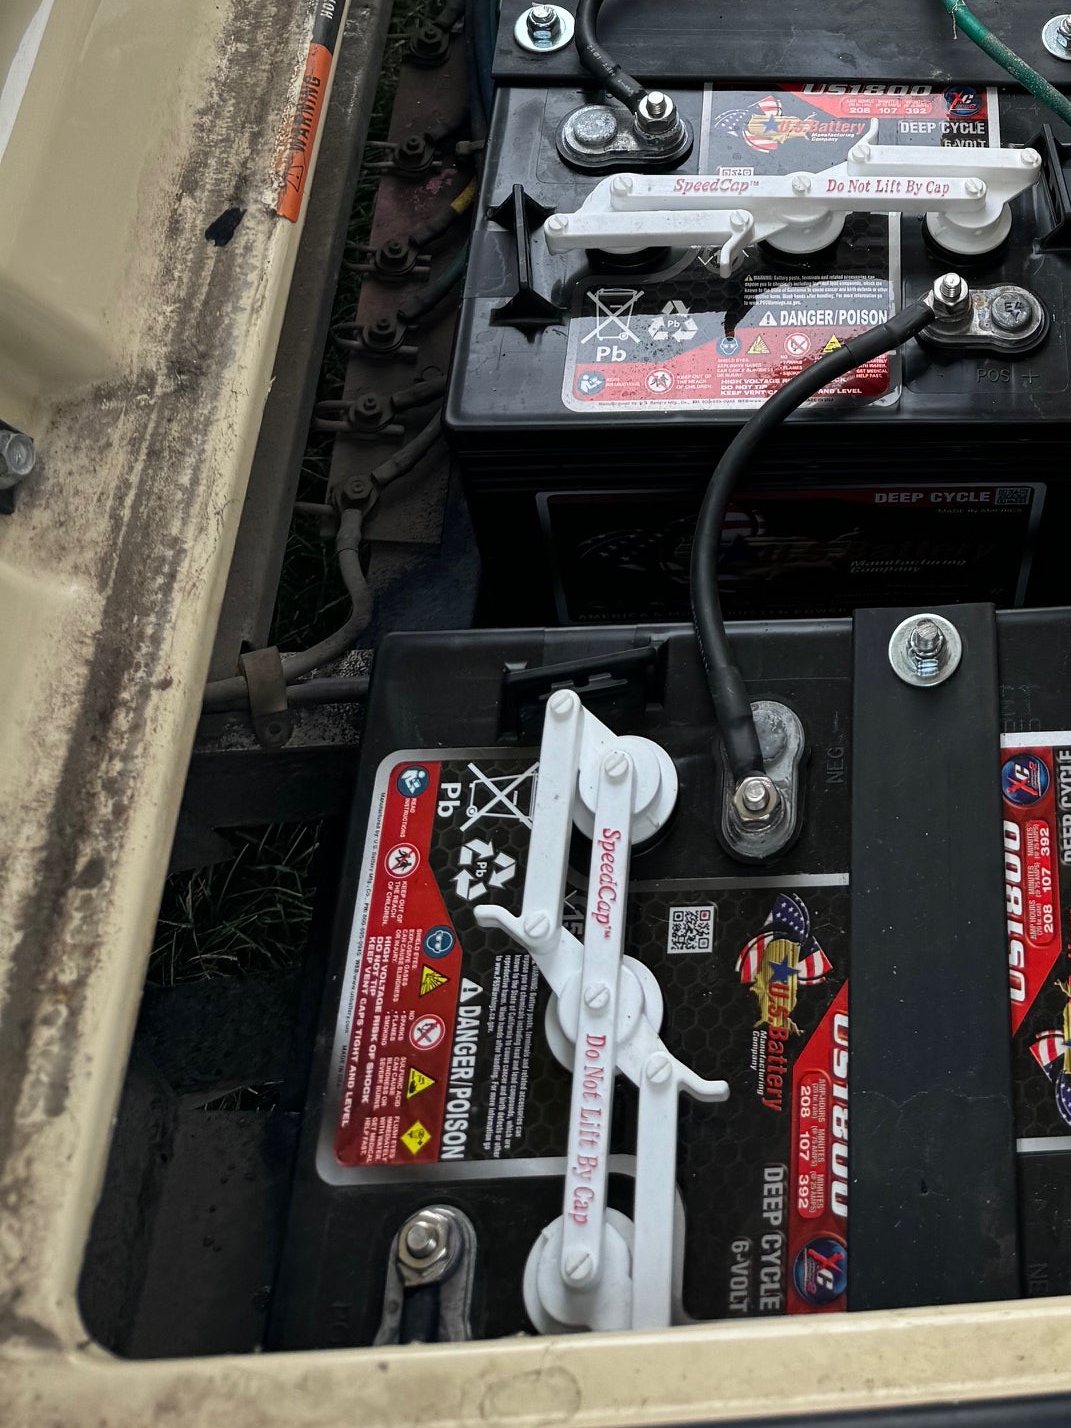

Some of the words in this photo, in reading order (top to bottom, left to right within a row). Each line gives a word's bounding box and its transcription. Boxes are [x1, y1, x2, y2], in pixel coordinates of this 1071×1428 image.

[803, 83, 931, 96] US1800
[290, 75, 321, 153] WARNING
[878, 107, 896, 115] 107
[906, 107, 926, 115] 392
[898, 121, 935, 135] DEEP
[938, 121, 984, 135] CYCLE
[944, 138, 987, 148] 6-VOLT
[827, 177, 844, 194] Do
[848, 177, 869, 195] Not
[876, 178, 900, 196] Lift
[906, 179, 921, 196] By
[926, 180, 949, 197] Cap
[668, 320, 680, 328] Pb
[780, 309, 888, 326] DANGER/POISON
[596, 346, 627, 362] Pb
[976, 368, 1011, 383] POS
[873, 491, 928, 504] DEEP
[930, 490, 991, 504] CYCLE
[825, 746, 844, 784] NEG
[409, 797, 418, 813] READ
[437, 782, 462, 818] Pb
[1039, 827, 1051, 855] 392
[475, 861, 488, 877] Pb
[1041, 867, 1053, 891] 107
[387, 881, 394, 890] OF
[393, 881, 401, 894] THE
[400, 880, 409, 898] KEEP
[381, 891, 393, 926] CHILDREN.
[390, 894, 399, 917] REACH
[396, 914, 404, 923] OF
[398, 899, 406, 912] OUT
[1003, 820, 1026, 1003] US1800
[1042, 904, 1055, 932] 208
[365, 936, 377, 963] KEEP
[374, 935, 384, 952] DO
[381, 935, 393, 962] HIGH
[371, 954, 382, 976] NOT
[360, 966, 372, 994] VENT
[368, 978, 378, 996] TIP
[373, 964, 388, 1012] VOLTAGE
[356, 997, 367, 1026] CAPS
[369, 1014, 380, 1041] RISK
[350, 1028, 363, 1061] TIGHT
[366, 1044, 376, 1059] OF
[584, 1034, 606, 1059] Do
[750, 1030, 760, 1071] Company
[346, 1065, 357, 1088] AND
[756, 1030, 768, 1096] Manufacturing
[763, 1025, 788, 1110] Battery
[360, 1061, 373, 1103] SHOCK
[440, 1005, 482, 1159] DANGER/POISON
[580, 1066, 603, 1099] Not
[340, 1091, 353, 1127] LEVEL
[800, 1086, 812, 1117] 208
[832, 1013, 849, 1217] US1800
[577, 1108, 600, 1146] Lift
[799, 1131, 811, 1160] 107
[574, 1155, 596, 1179] By
[761, 1166, 783, 1225] DEEP
[798, 1174, 810, 1208] 392
[570, 1186, 594, 1227] Cap
[729, 1240, 751, 1313] 6-VOLT
[759, 1234, 781, 1309] CYCLE
